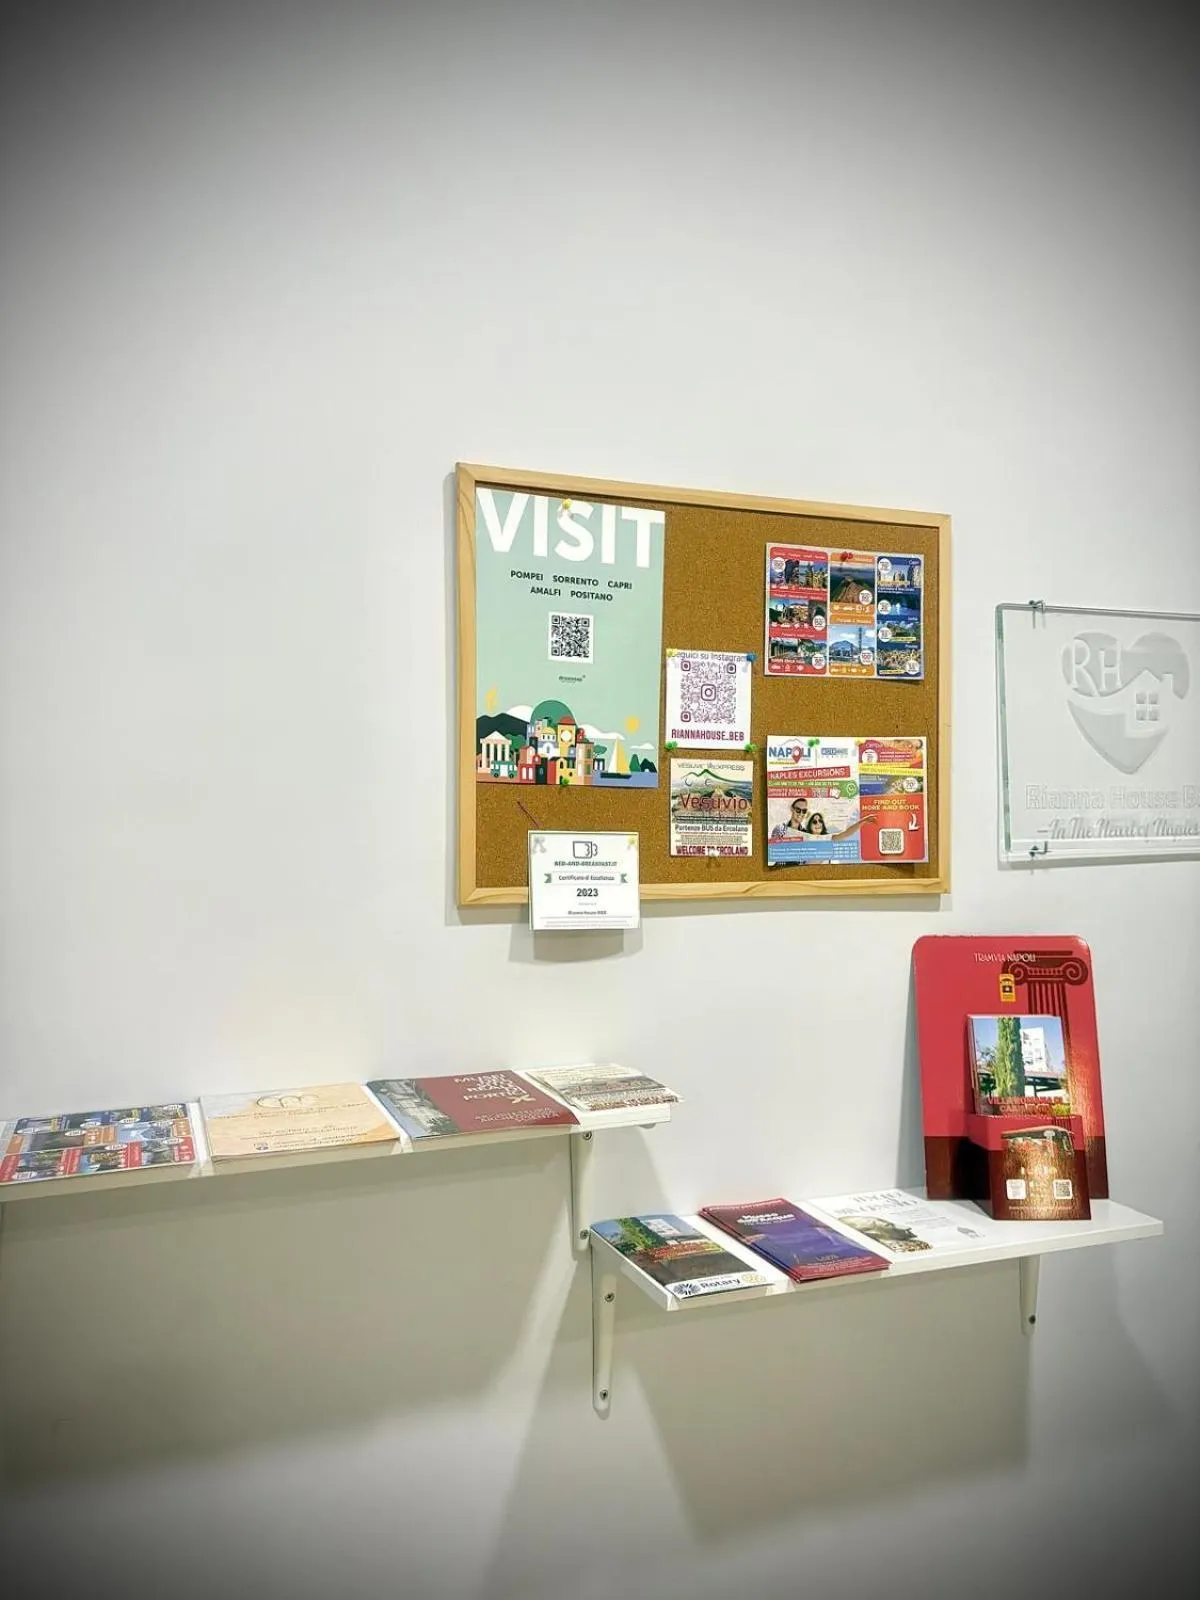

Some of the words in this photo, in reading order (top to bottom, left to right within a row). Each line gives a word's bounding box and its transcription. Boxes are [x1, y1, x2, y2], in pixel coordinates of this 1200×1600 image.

[476, 487, 665, 568] VISIT
[510, 570, 544, 581] POMPEI
[552, 575, 599, 587] SORRENTO
[607, 580, 633, 590] CAPRI
[530, 586, 561, 597] AMALFI
[570, 590, 613, 602] POSITANO
[700, 652, 709, 660] su
[771, 771, 798, 779] NAPLES
[799, 768, 846, 778] EXCURSIONS
[680, 793, 748, 810] Vesuvio
[676, 845, 706, 855] WELCOME
[576, 888, 599, 897] 2023
[700, 1278, 741, 1289] Rotary
